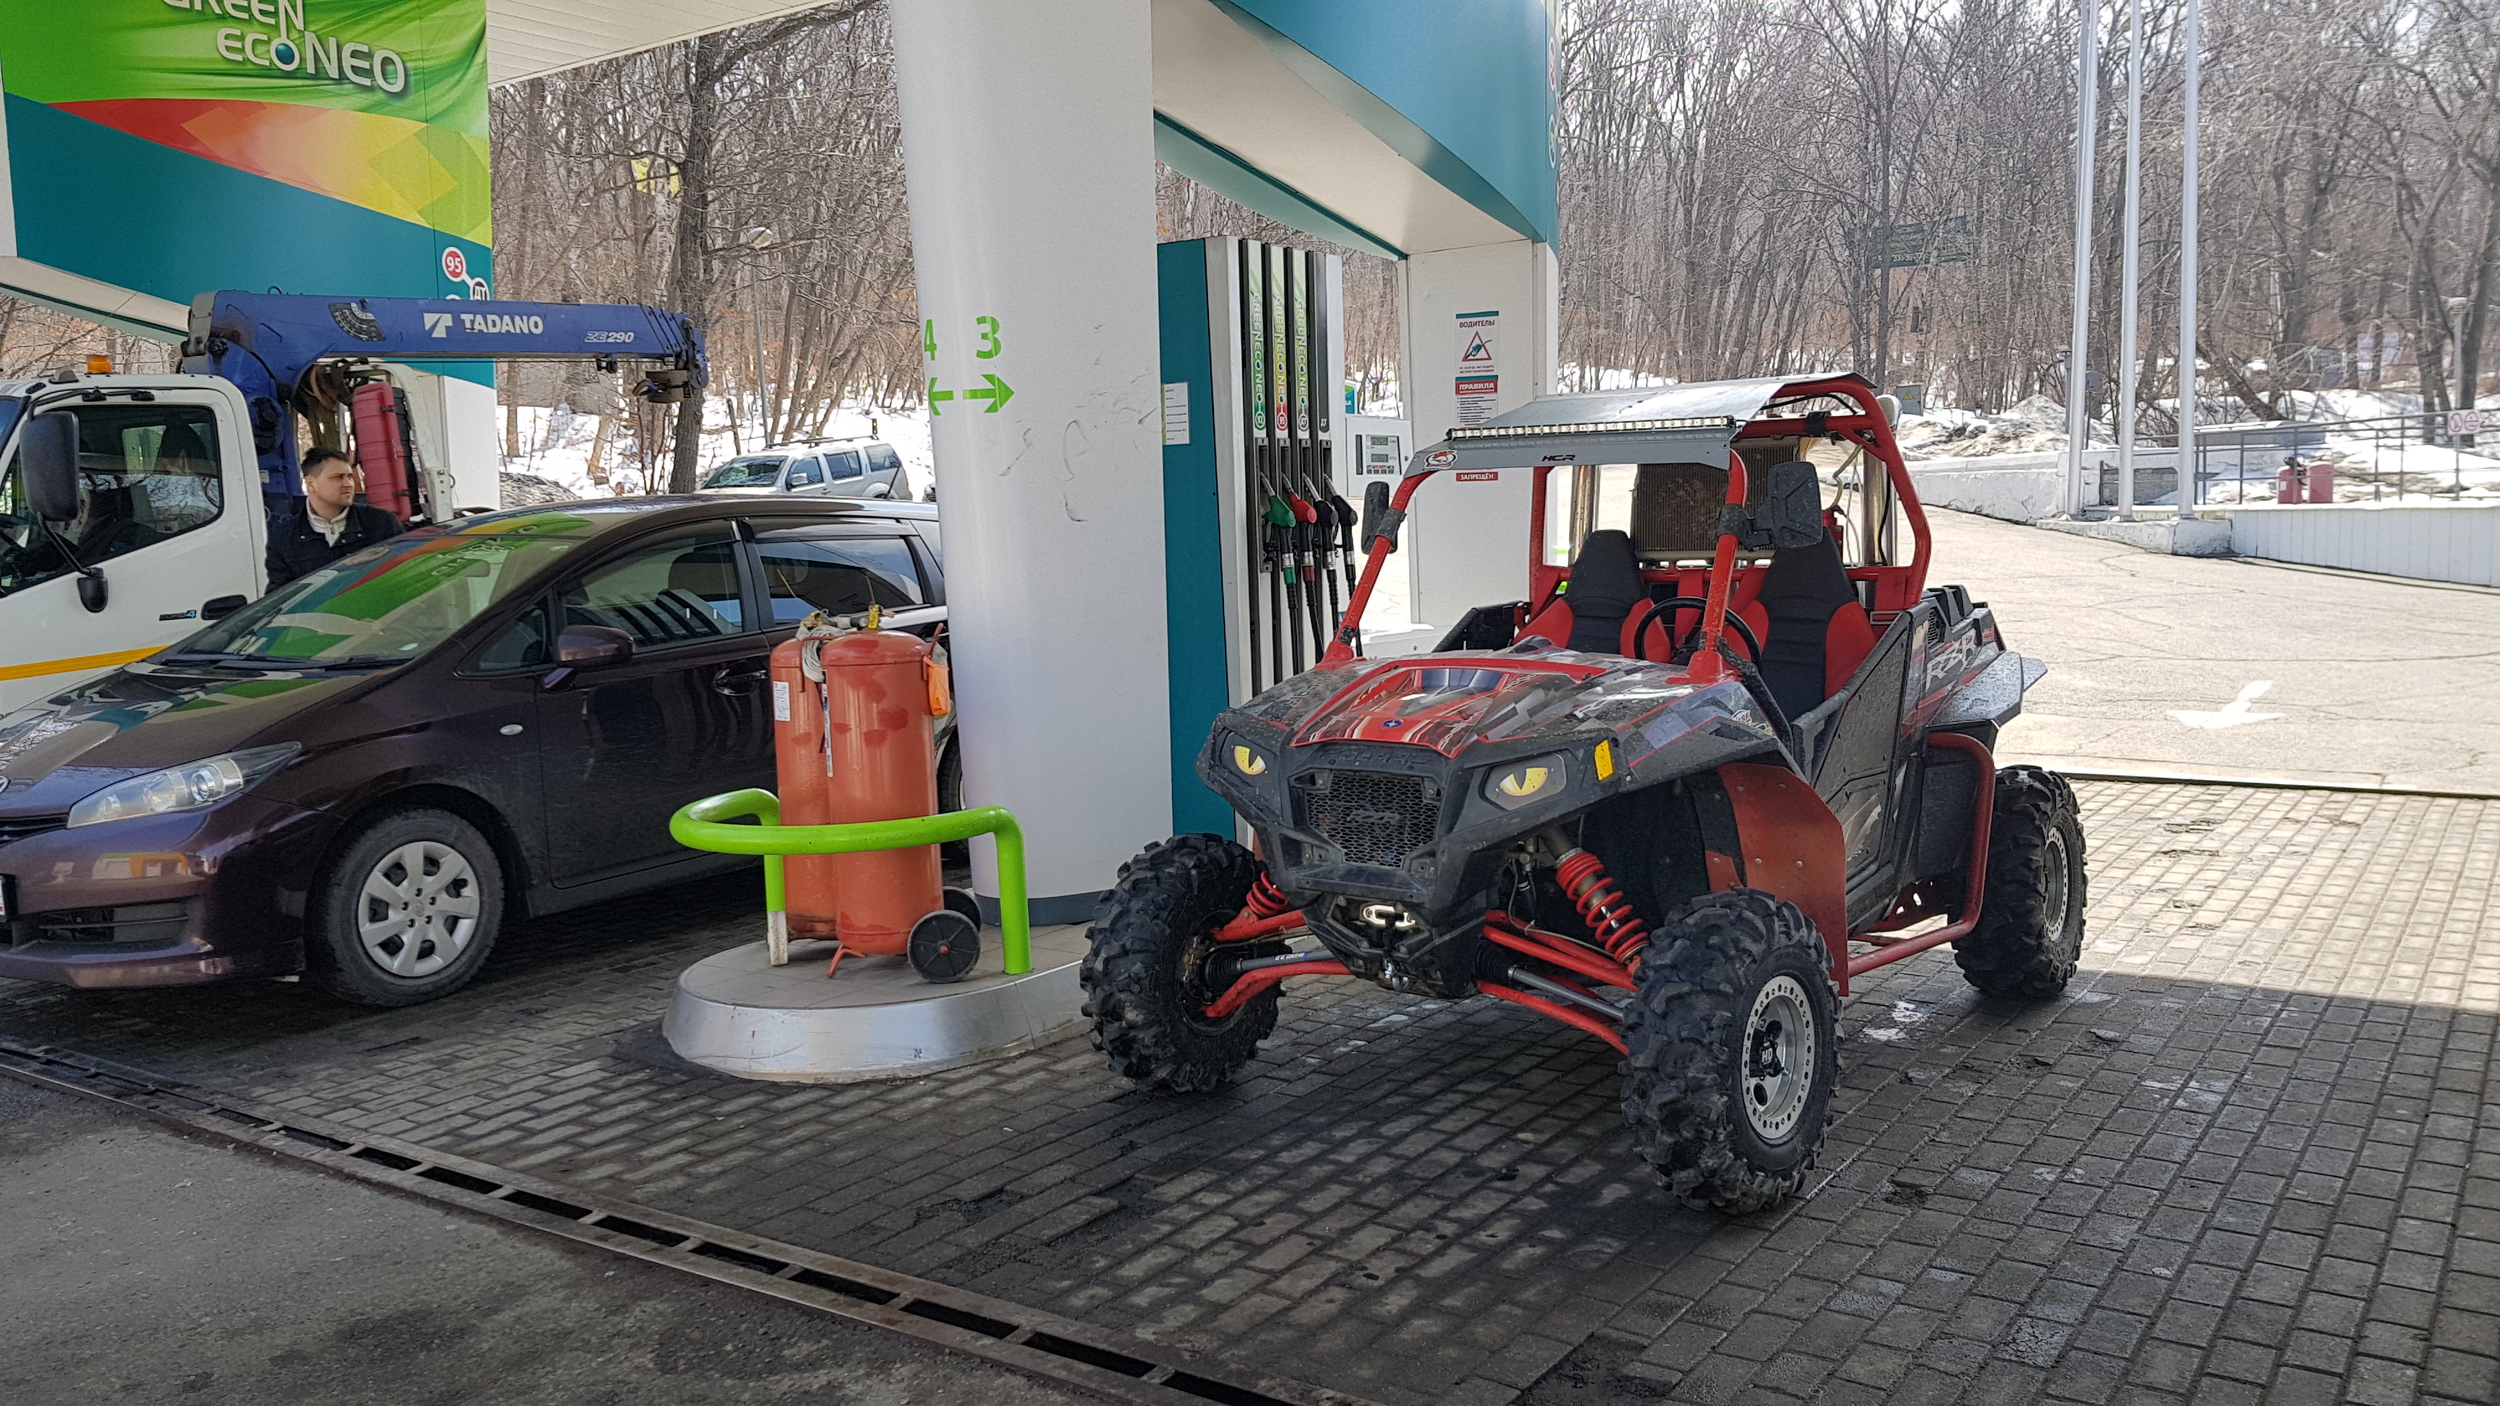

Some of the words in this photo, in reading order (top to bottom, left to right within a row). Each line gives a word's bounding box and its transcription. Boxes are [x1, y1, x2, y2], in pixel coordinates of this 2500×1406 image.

[163, 0, 304, 31] EEN
[446, 256, 462, 273] 95
[460, 313, 544, 335] TADANO
[924, 319, 937, 361] 4
[976, 316, 1001, 359] 3
[1459, 383, 1495, 391] ПРАВИЛА
